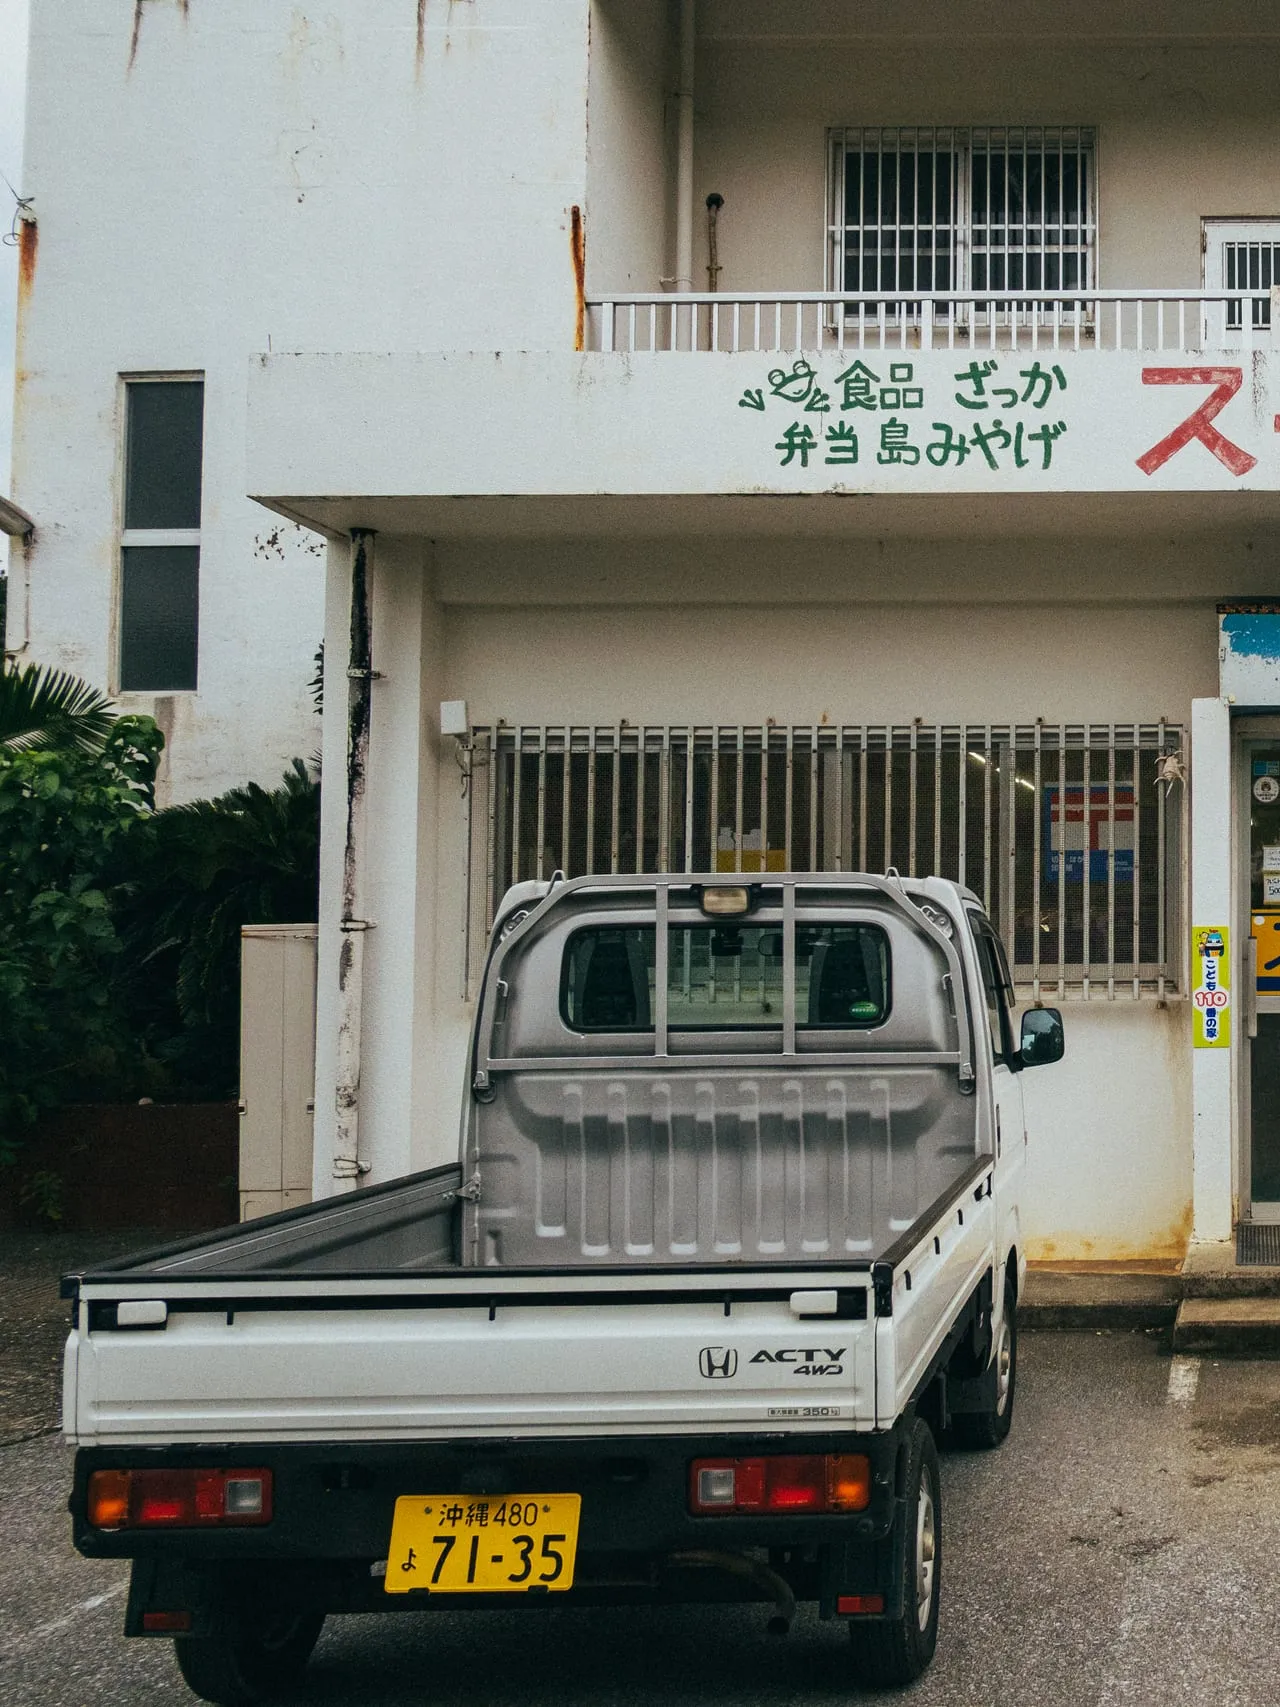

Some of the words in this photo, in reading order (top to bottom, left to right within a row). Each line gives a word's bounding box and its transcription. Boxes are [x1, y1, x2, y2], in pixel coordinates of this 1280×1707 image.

[835, 360, 923, 411] 食品
[954, 360, 1067, 410] ざっか
[775, 421, 860, 467] 弁当
[877, 417, 1067, 471] 島みやげ
[749, 1348, 847, 1363] ACTY
[793, 1364, 843, 1376] 4WD
[802, 1407, 829, 1417] 350
[401, 1547, 417, 1572] よ
[431, 1534, 566, 1584] 71-35
